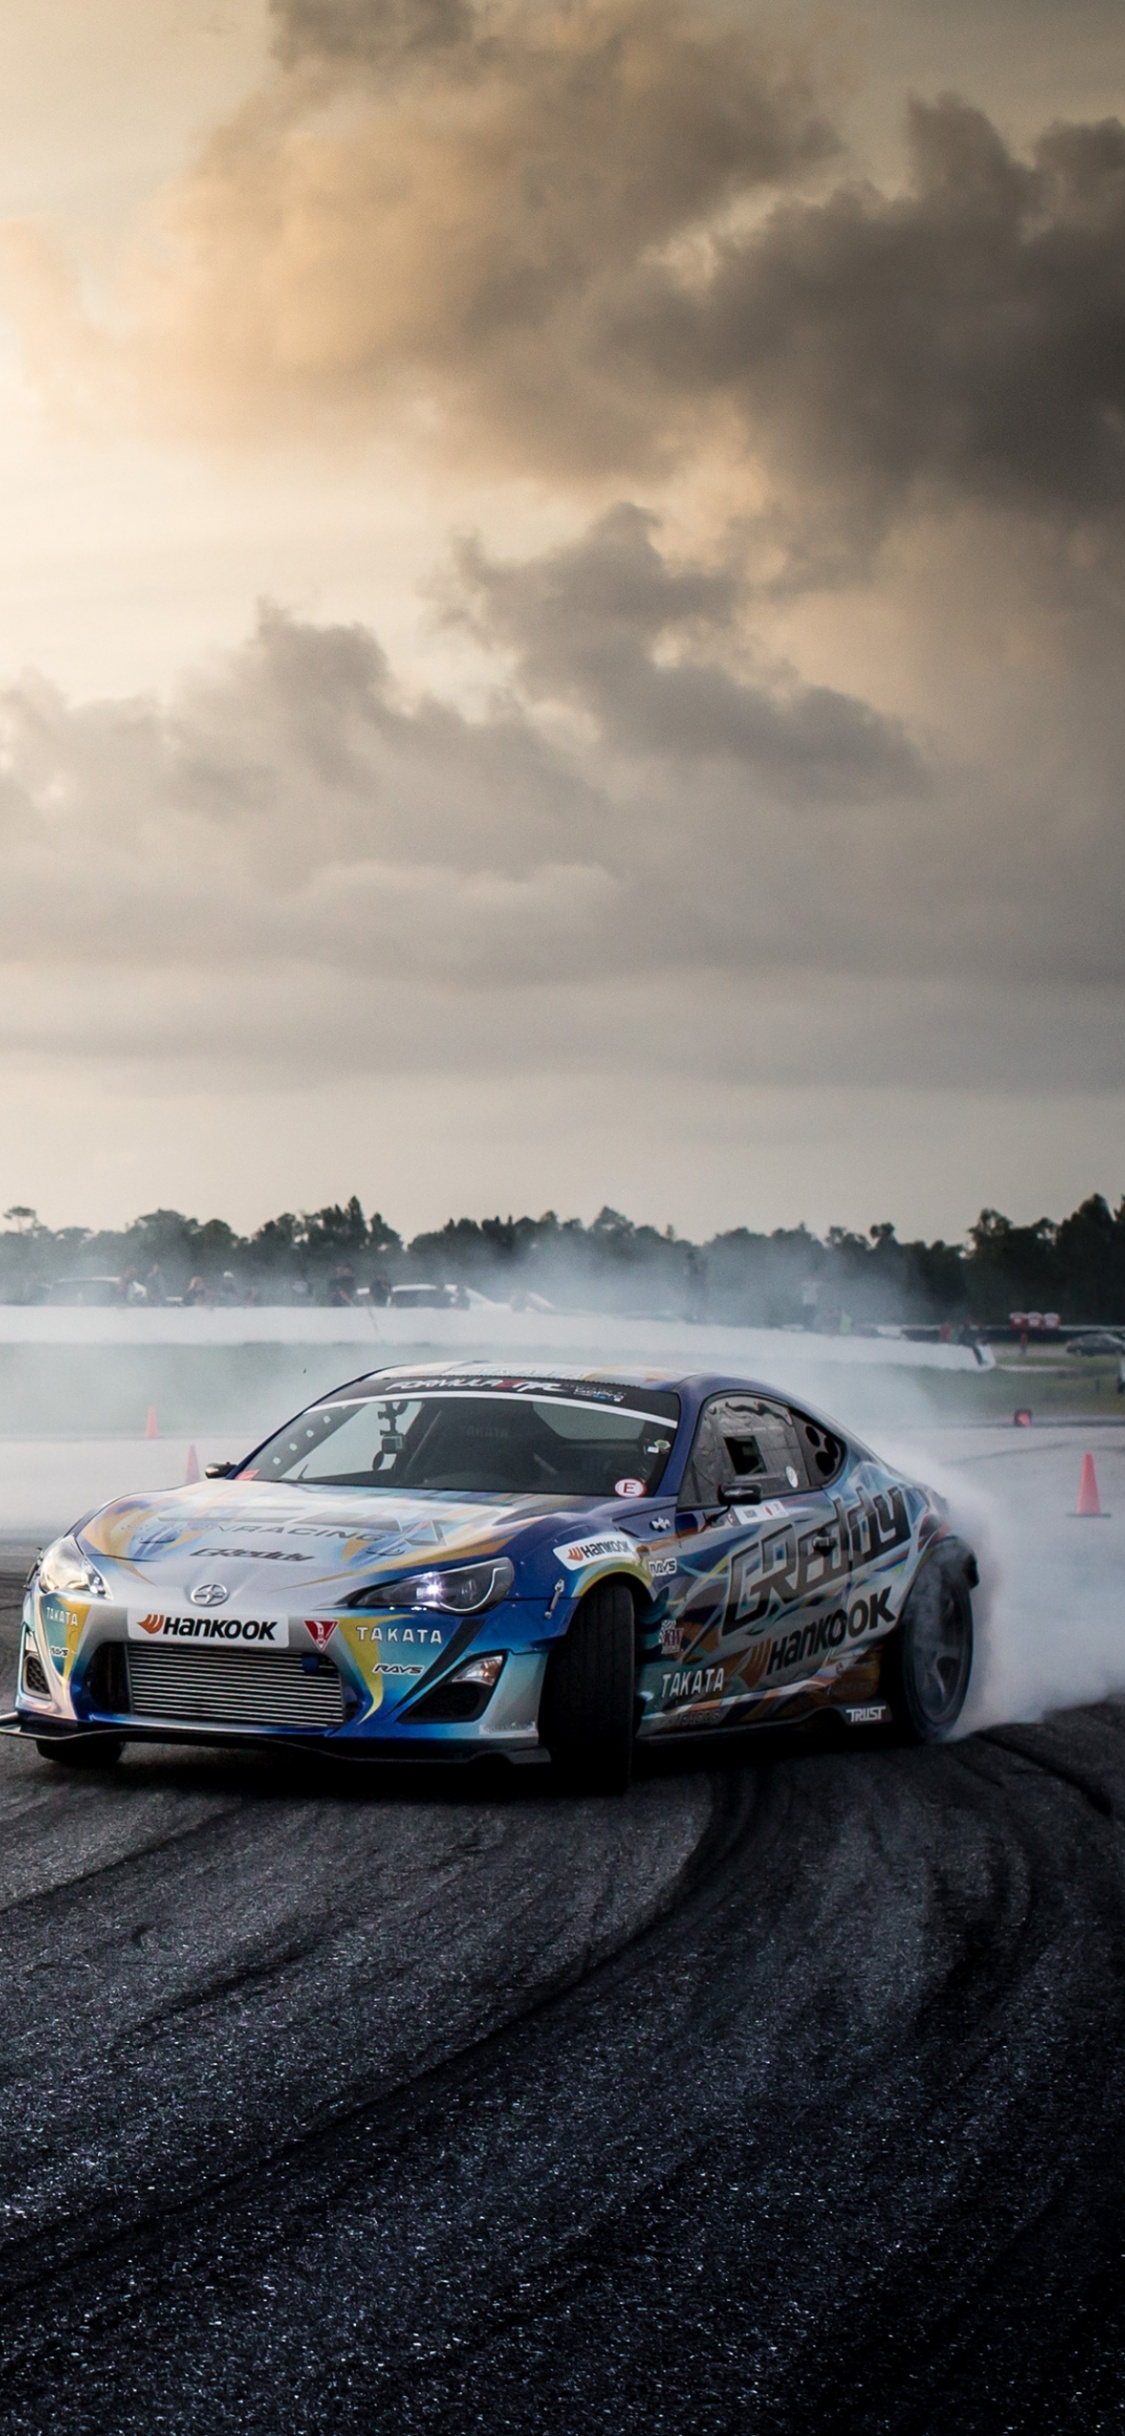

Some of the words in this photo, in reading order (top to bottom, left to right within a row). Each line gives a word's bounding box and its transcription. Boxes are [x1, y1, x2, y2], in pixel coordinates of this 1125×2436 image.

[385, 1379, 503, 1391] FORMULA
[623, 1482, 636, 1494] E
[46, 1606, 78, 1627] TAKATA
[356, 1626, 443, 1645] TAKATA
[661, 1667, 725, 1698] TAKATA
[846, 1706, 886, 1722] TRUST
